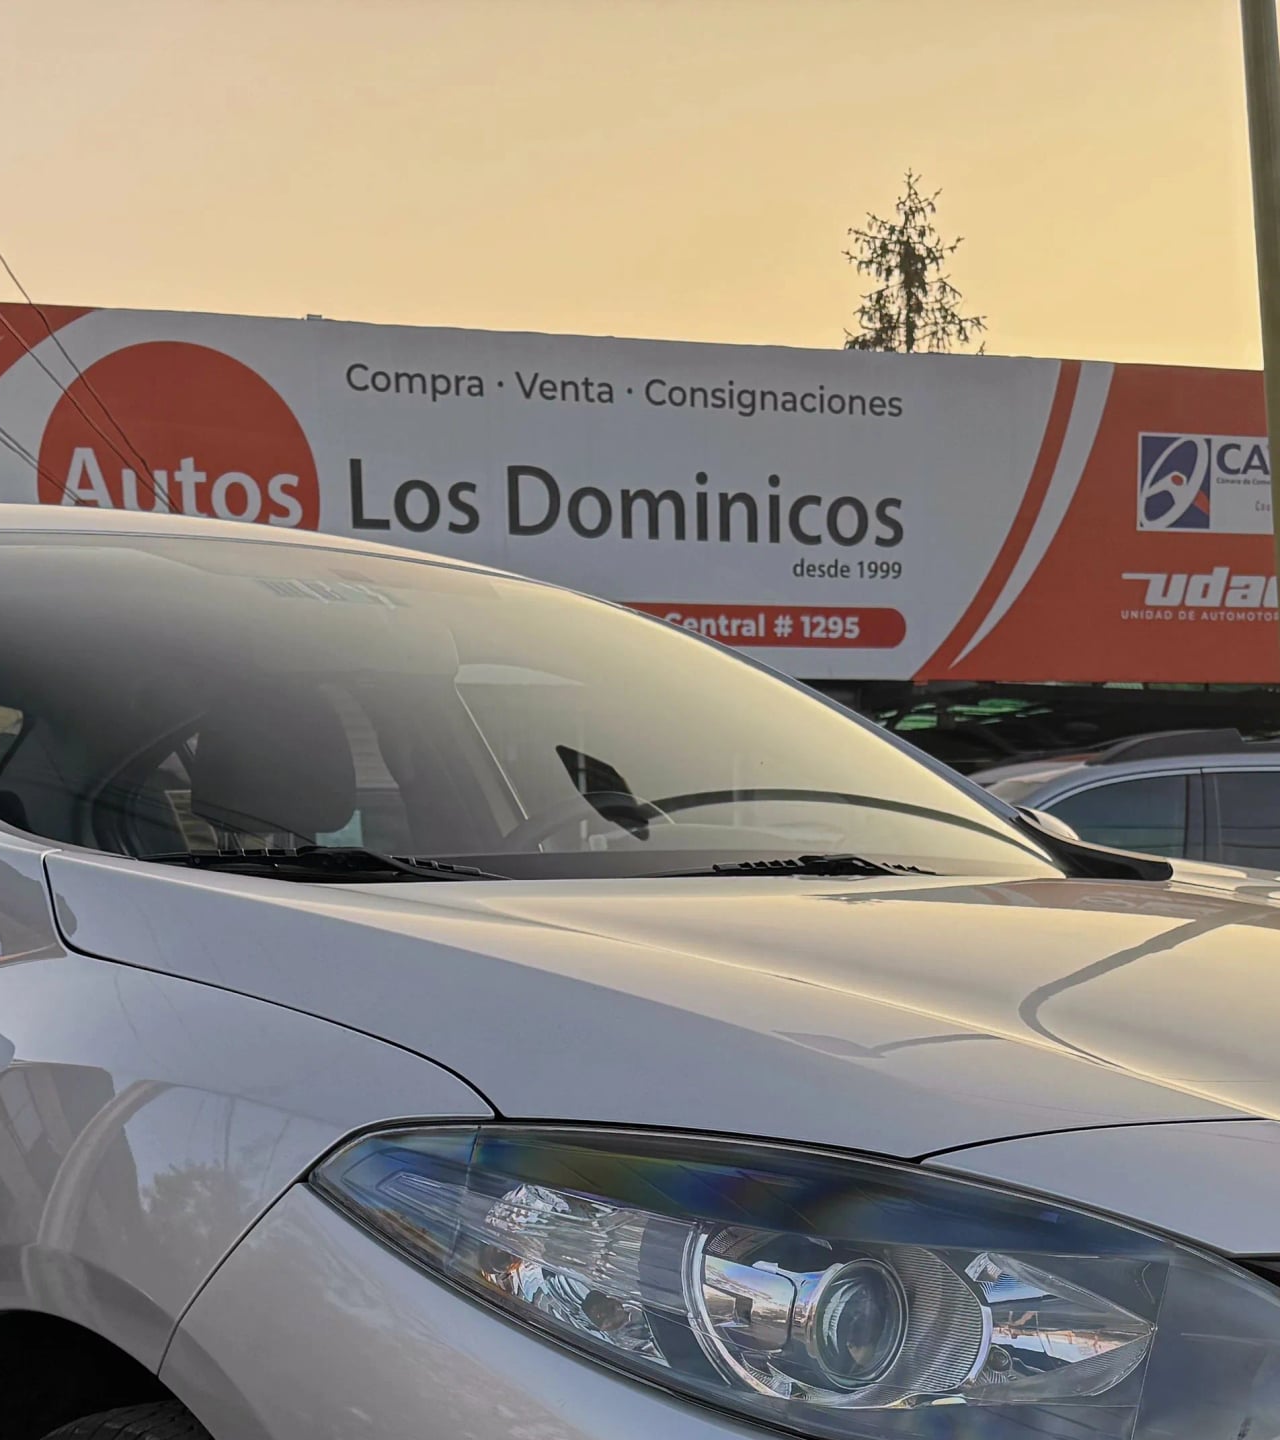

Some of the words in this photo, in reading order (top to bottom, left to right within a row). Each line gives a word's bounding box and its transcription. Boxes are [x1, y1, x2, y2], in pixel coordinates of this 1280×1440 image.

[346, 363, 484, 401] Compra
[515, 371, 614, 403] Venta
[645, 378, 903, 417] Consignaciones
[61, 447, 303, 528] Autos
[349, 458, 481, 535] Los
[507, 465, 904, 548] Dominicos
[793, 558, 850, 578] desde
[858, 560, 902, 579] 1999
[774, 615, 792, 638] #
[801, 615, 860, 639] 1295
[1121, 610, 1172, 621] UNIDAD
[1179, 611, 1196, 622] DE
